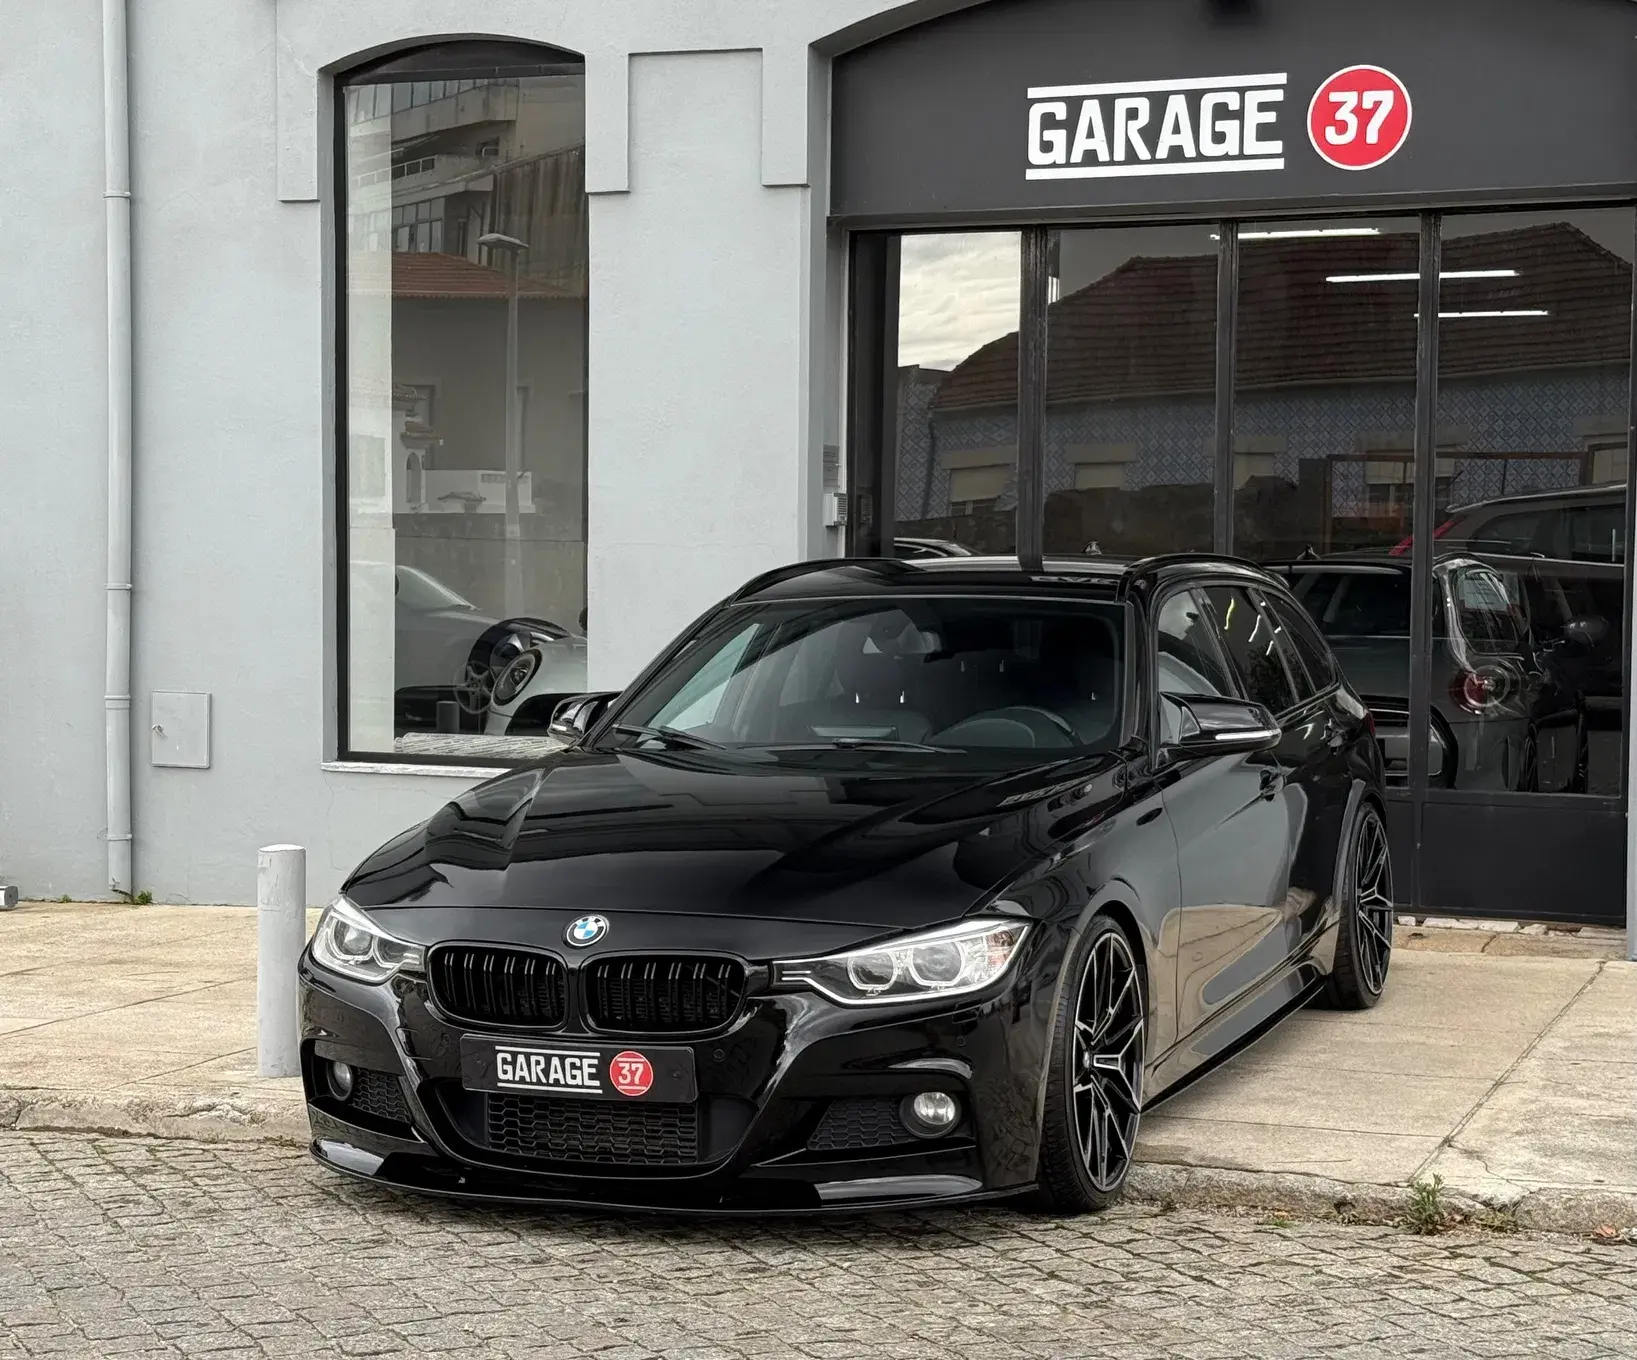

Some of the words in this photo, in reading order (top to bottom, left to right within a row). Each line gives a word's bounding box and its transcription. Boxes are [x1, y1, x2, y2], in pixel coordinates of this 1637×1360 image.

[1027, 89, 1284, 166] GARAGE
[1324, 90, 1395, 145] 37
[496, 1052, 601, 1087] GARAGE
[618, 1062, 644, 1085] 37
